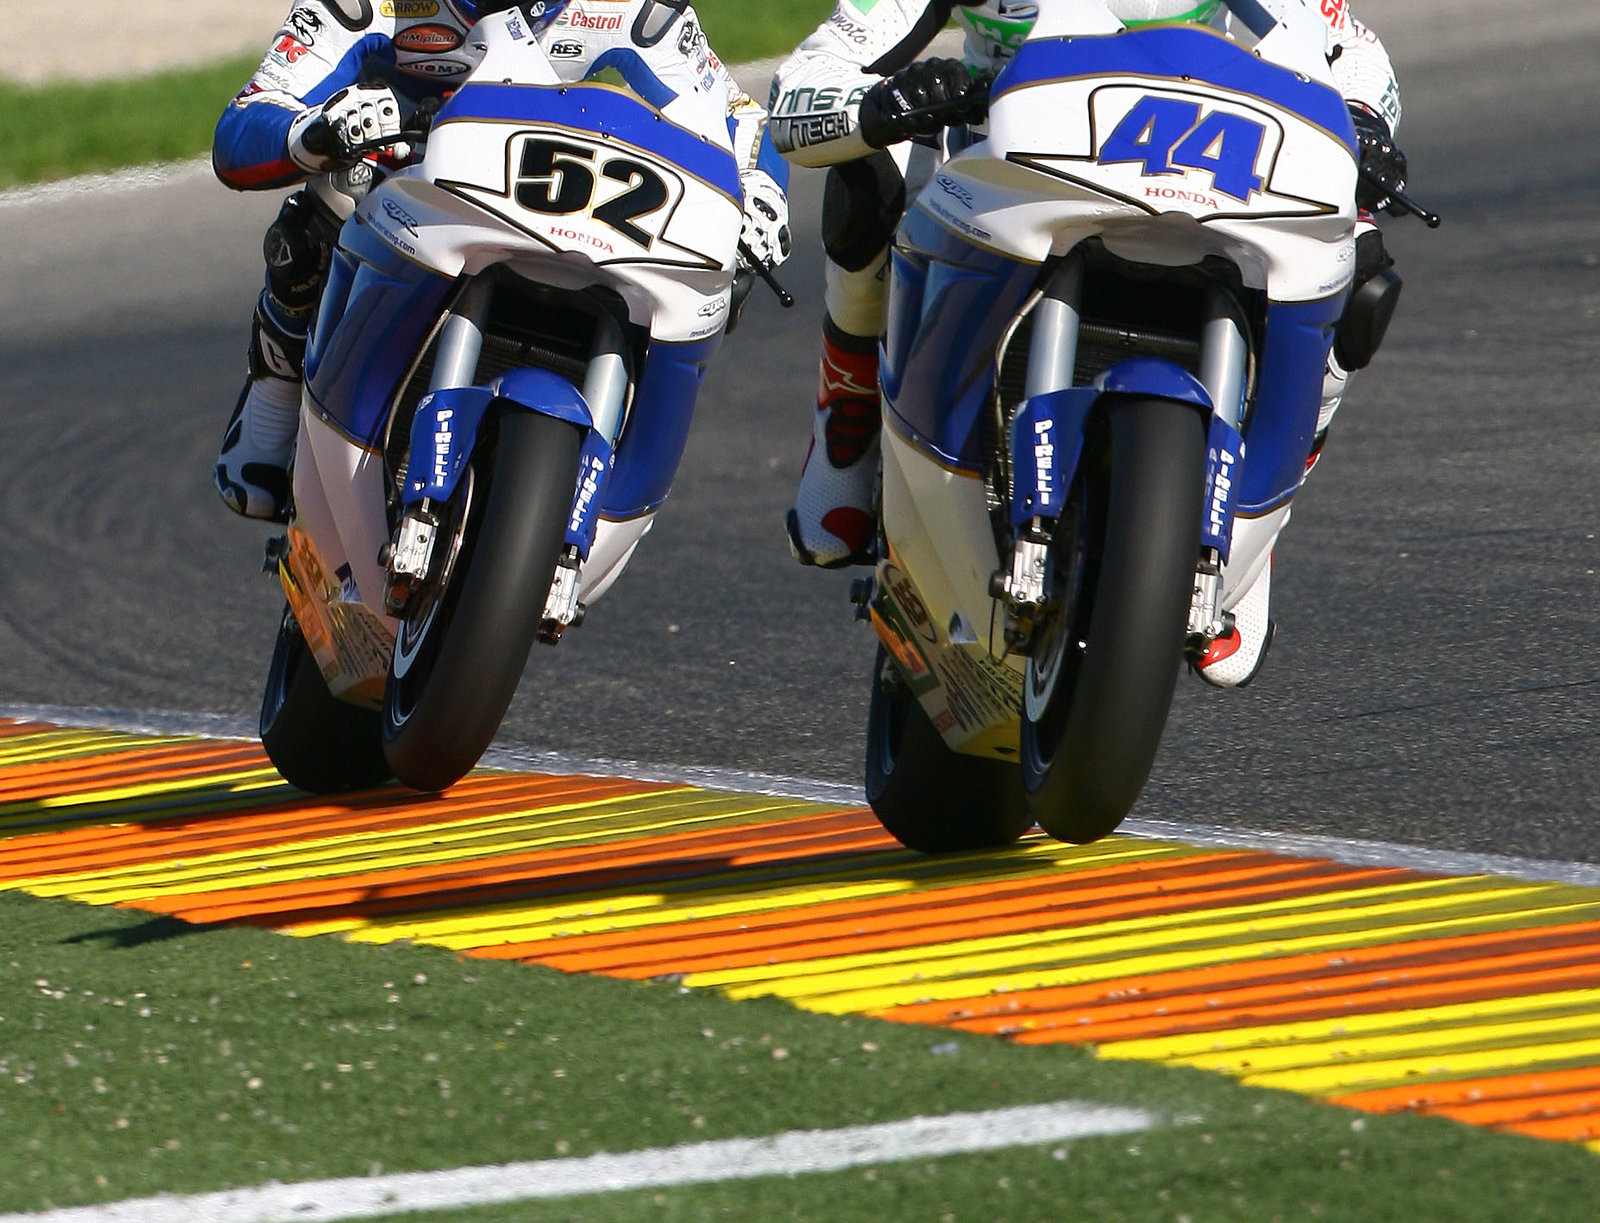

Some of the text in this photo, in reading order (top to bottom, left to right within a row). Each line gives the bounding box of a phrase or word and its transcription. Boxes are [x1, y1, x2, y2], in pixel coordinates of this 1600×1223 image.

[384, 1, 433, 13] ARROW
[570, 11, 623, 30] Castrol
[1097, 95, 1267, 206] 44
[514, 137, 669, 252] 52
[1144, 187, 1221, 210] HONDA
[549, 226, 615, 255] HONDA
[434, 408, 454, 488] PIRELLI
[1033, 418, 1054, 505] PIRELLI
[568, 455, 604, 532] PIRELLI
[1209, 448, 1235, 537] PIRELLI
